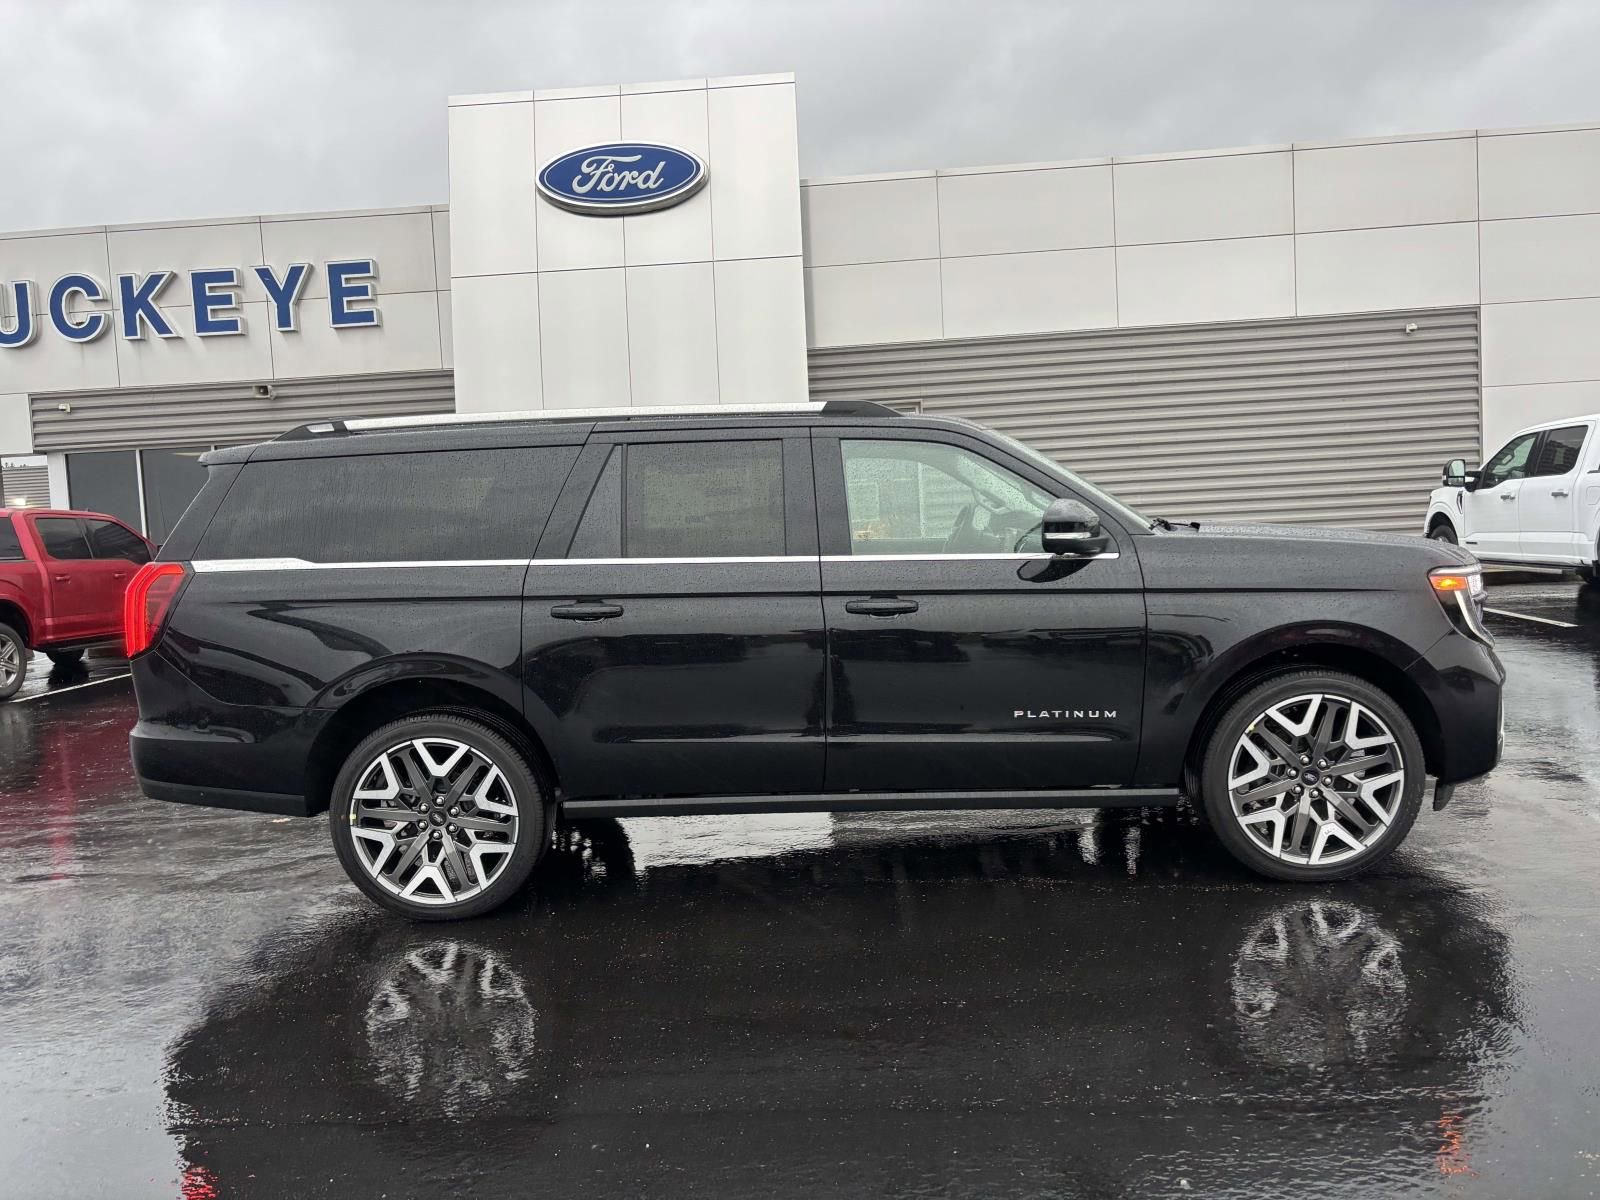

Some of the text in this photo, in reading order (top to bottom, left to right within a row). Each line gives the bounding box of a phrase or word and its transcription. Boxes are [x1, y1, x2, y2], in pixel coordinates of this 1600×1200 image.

[572, 154, 666, 193] Ford
[0, 259, 380, 348] UCKEYE
[1013, 710, 1117, 718] PLATINUM
